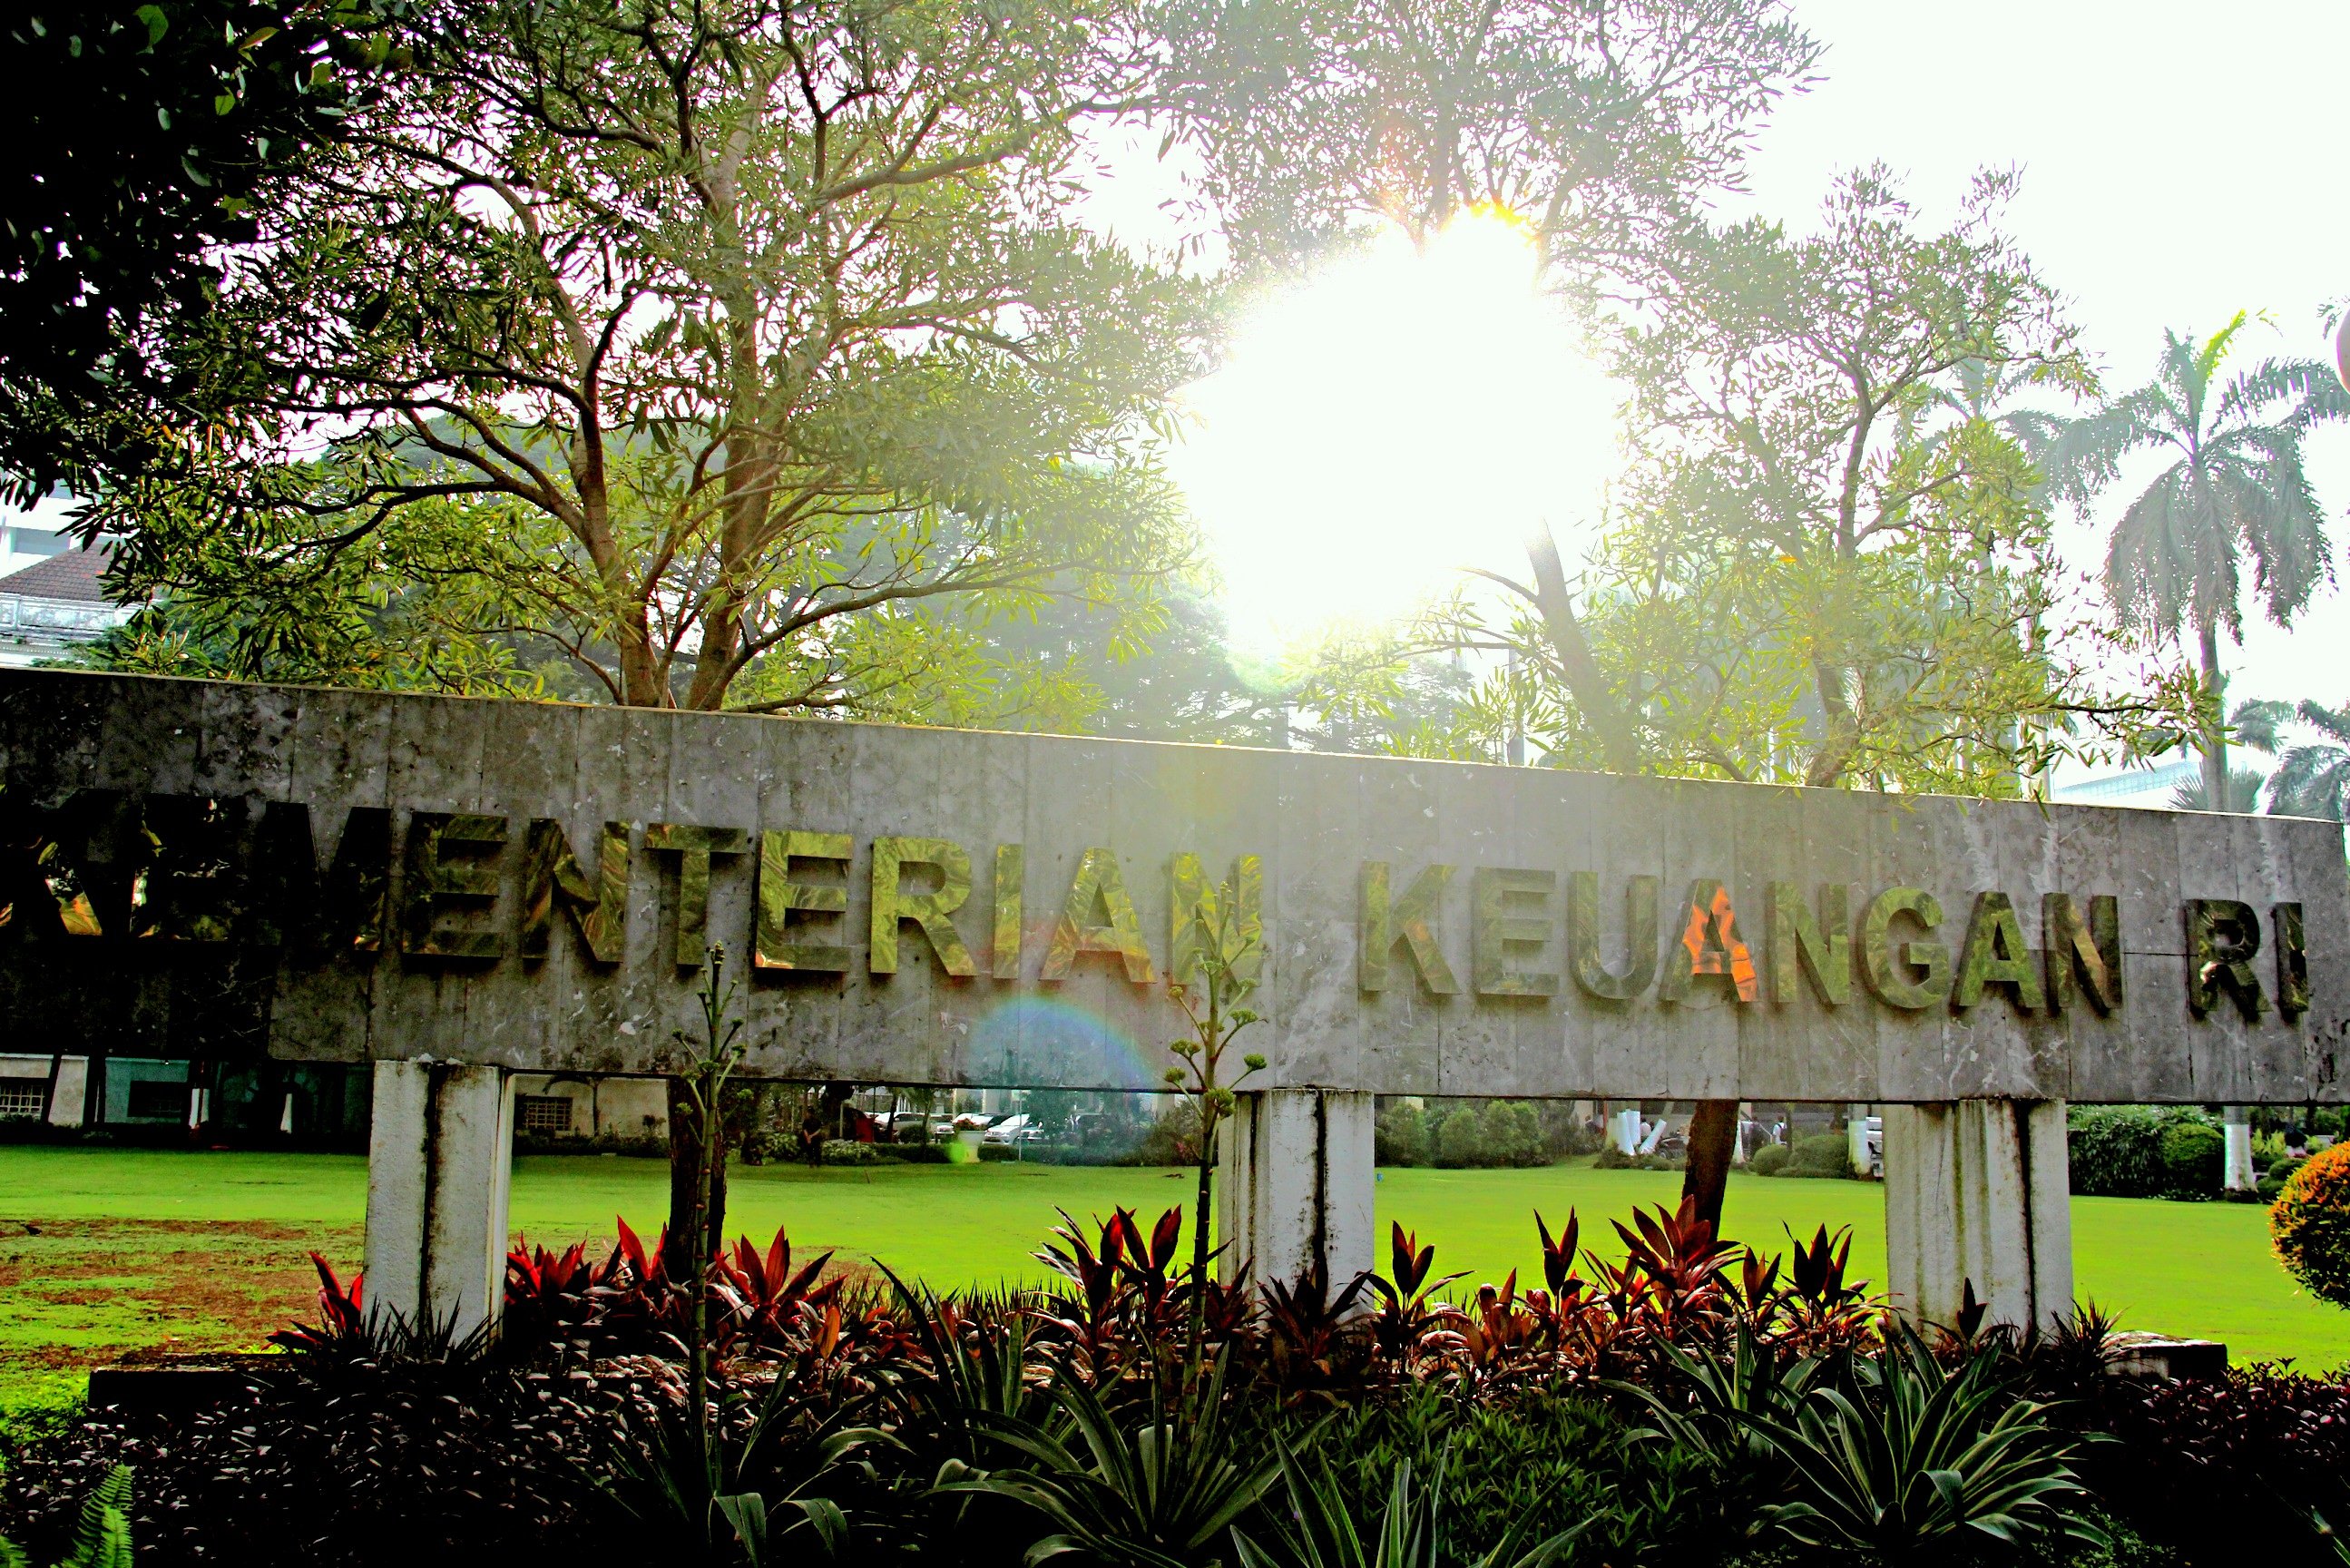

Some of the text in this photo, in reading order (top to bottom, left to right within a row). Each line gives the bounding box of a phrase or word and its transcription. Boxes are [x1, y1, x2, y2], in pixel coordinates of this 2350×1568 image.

[0, 786, 2309, 1014] KEMENTERIAN KEUANGAN RI
